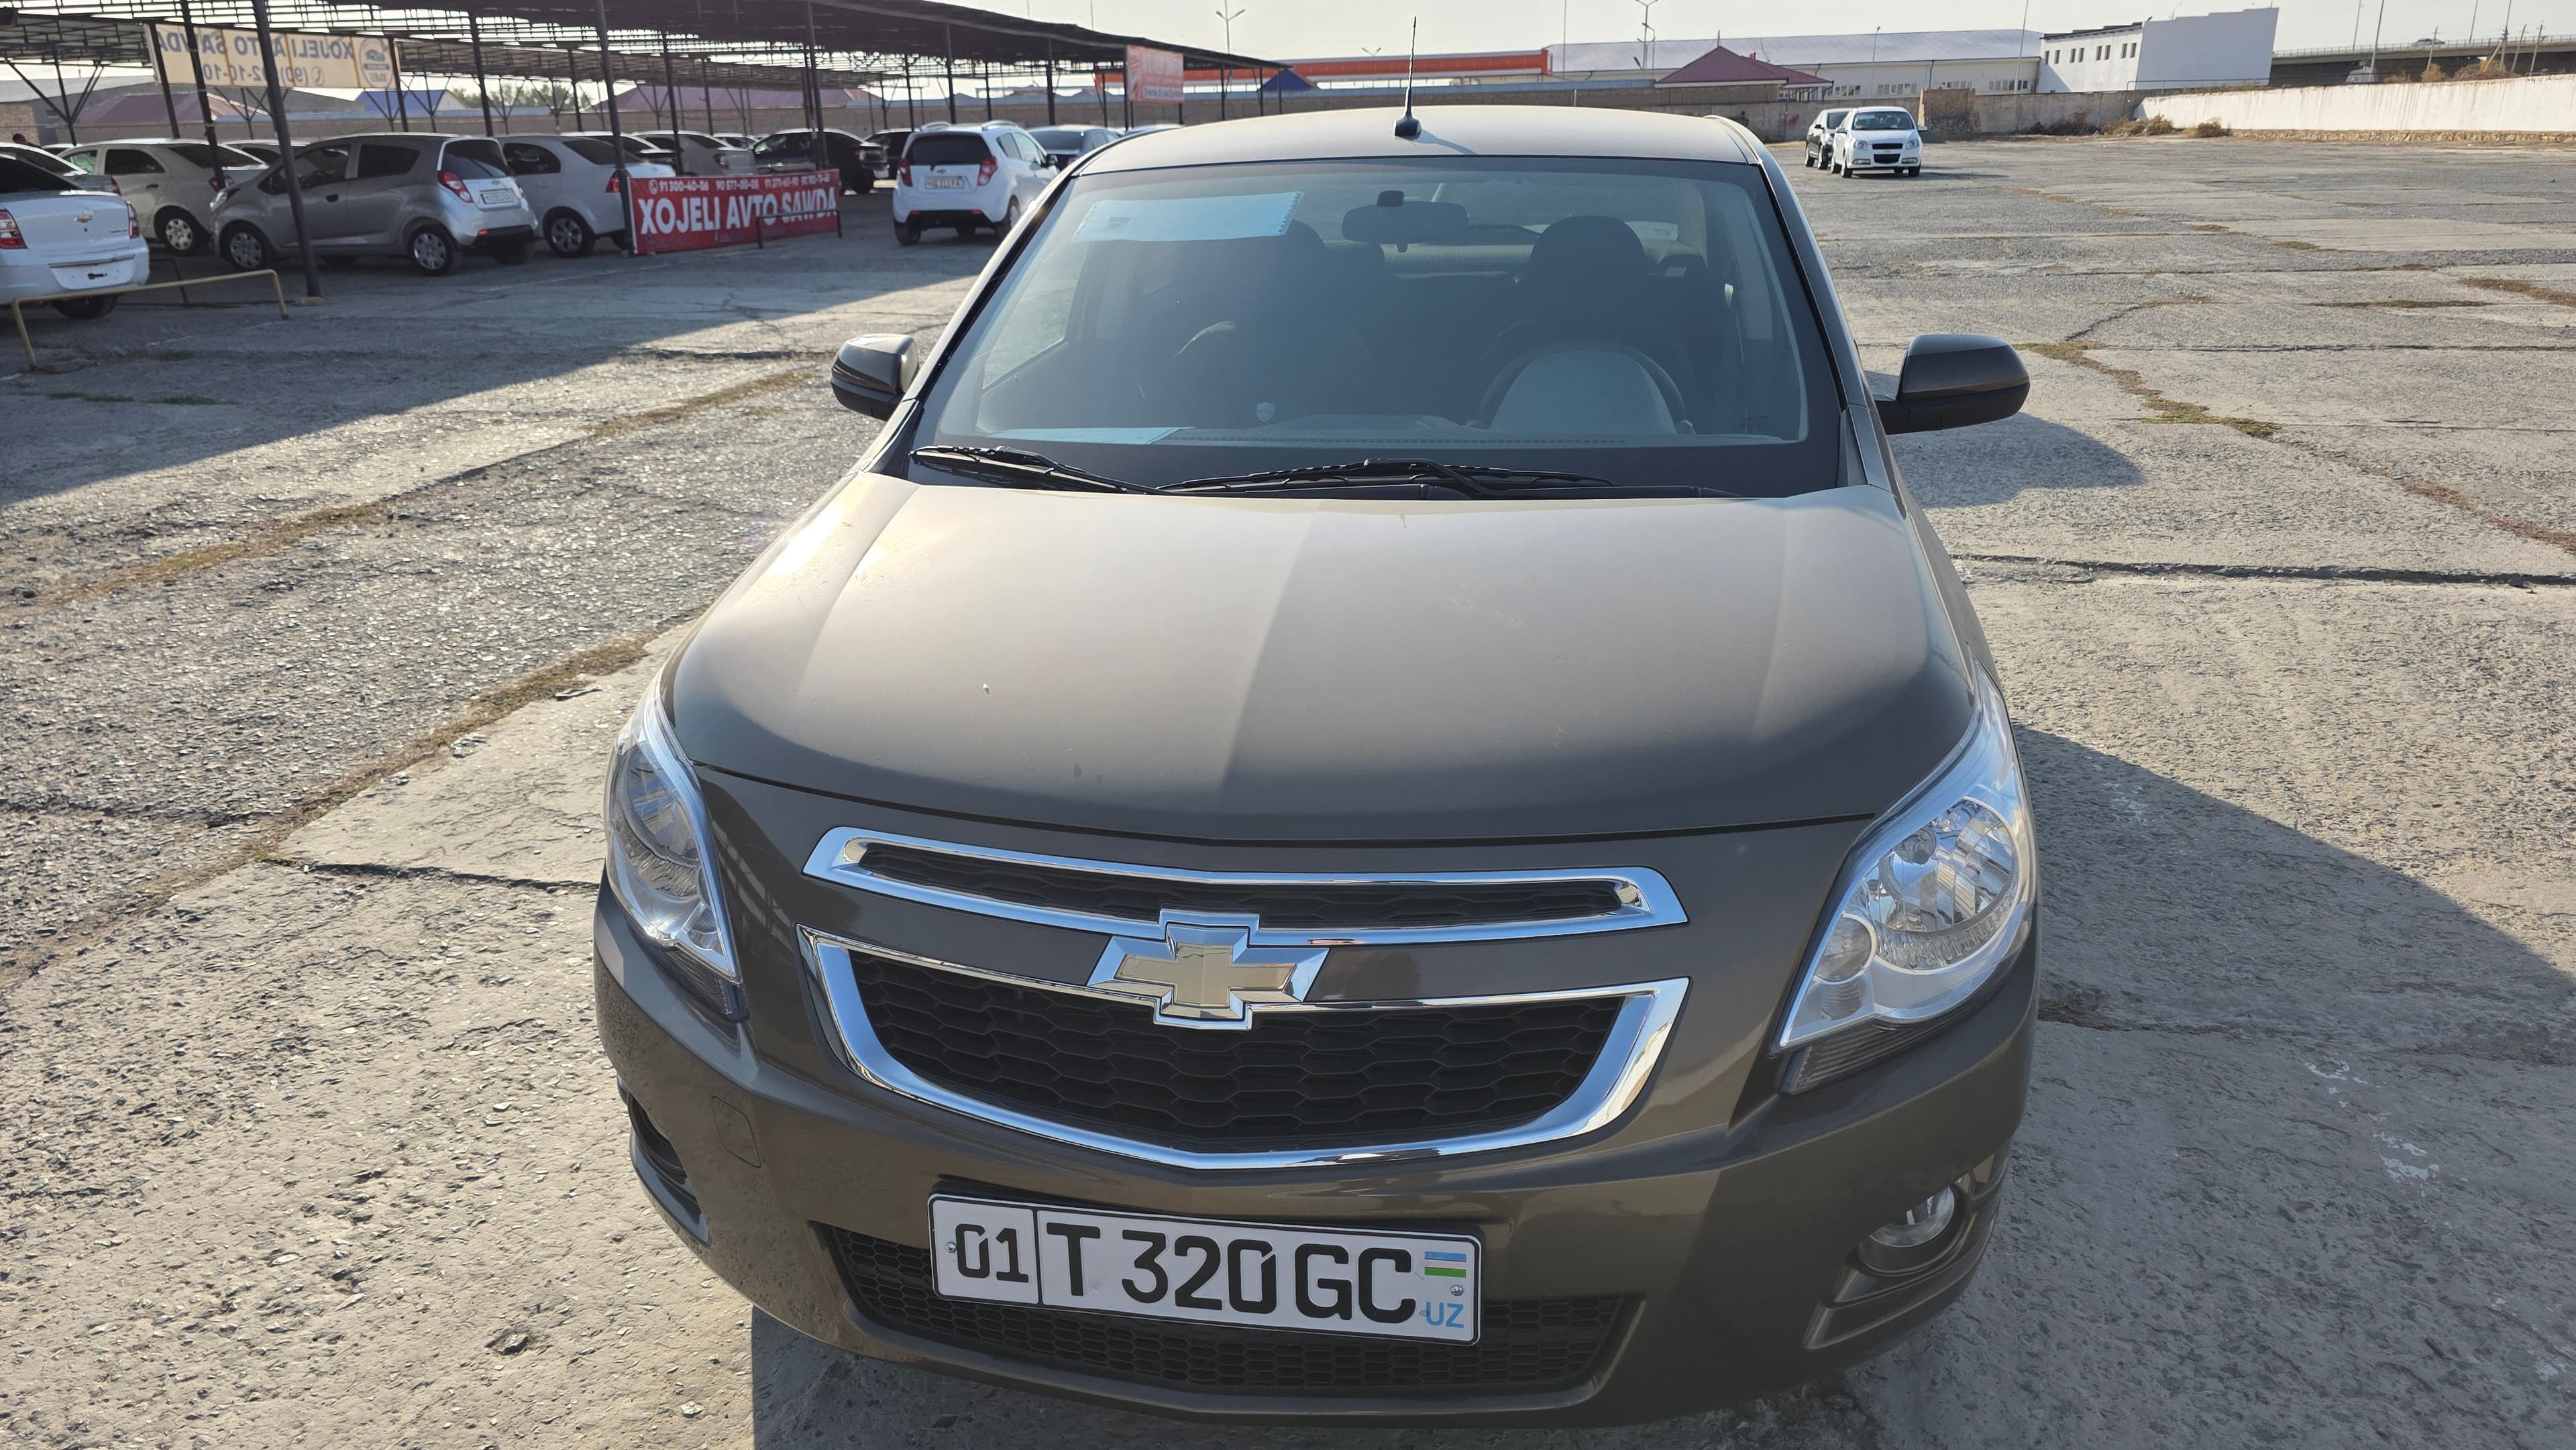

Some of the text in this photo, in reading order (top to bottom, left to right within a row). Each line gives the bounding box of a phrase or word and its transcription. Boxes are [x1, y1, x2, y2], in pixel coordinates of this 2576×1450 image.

[638, 187, 838, 235] XOJELI AVTO SAWDA
[955, 1222, 1416, 1325] 01 T 320 GC
[1426, 1301, 1464, 1329] UZ
